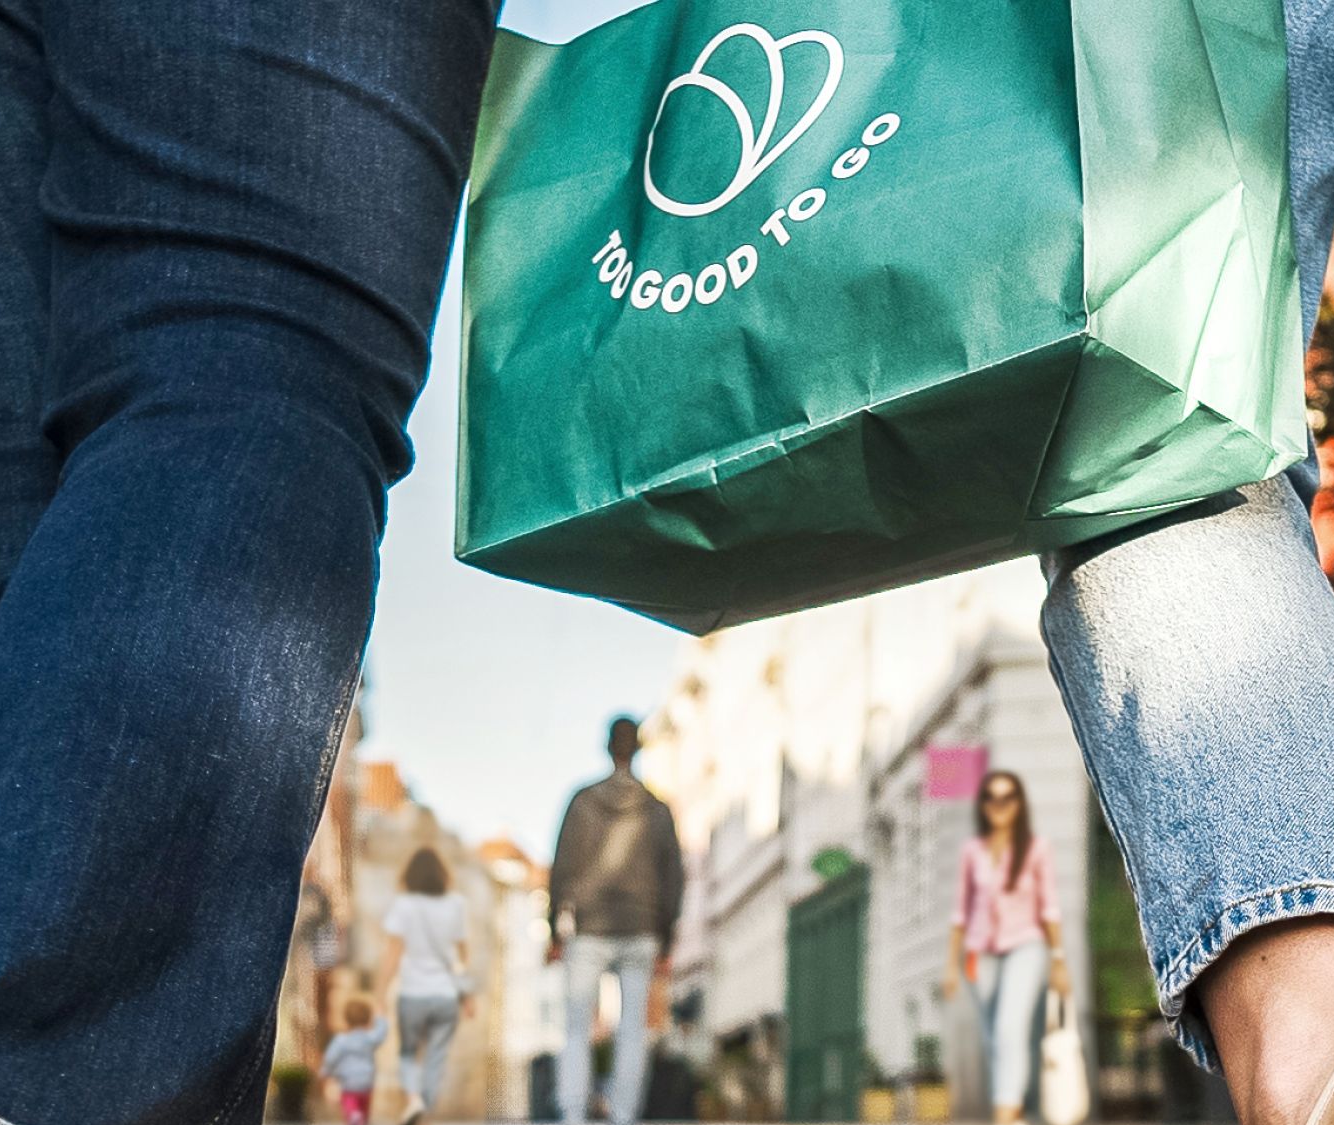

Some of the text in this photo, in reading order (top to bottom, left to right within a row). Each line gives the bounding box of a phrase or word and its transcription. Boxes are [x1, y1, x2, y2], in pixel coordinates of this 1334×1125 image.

[592, 112, 901, 313] TOO GOOD TO GO
